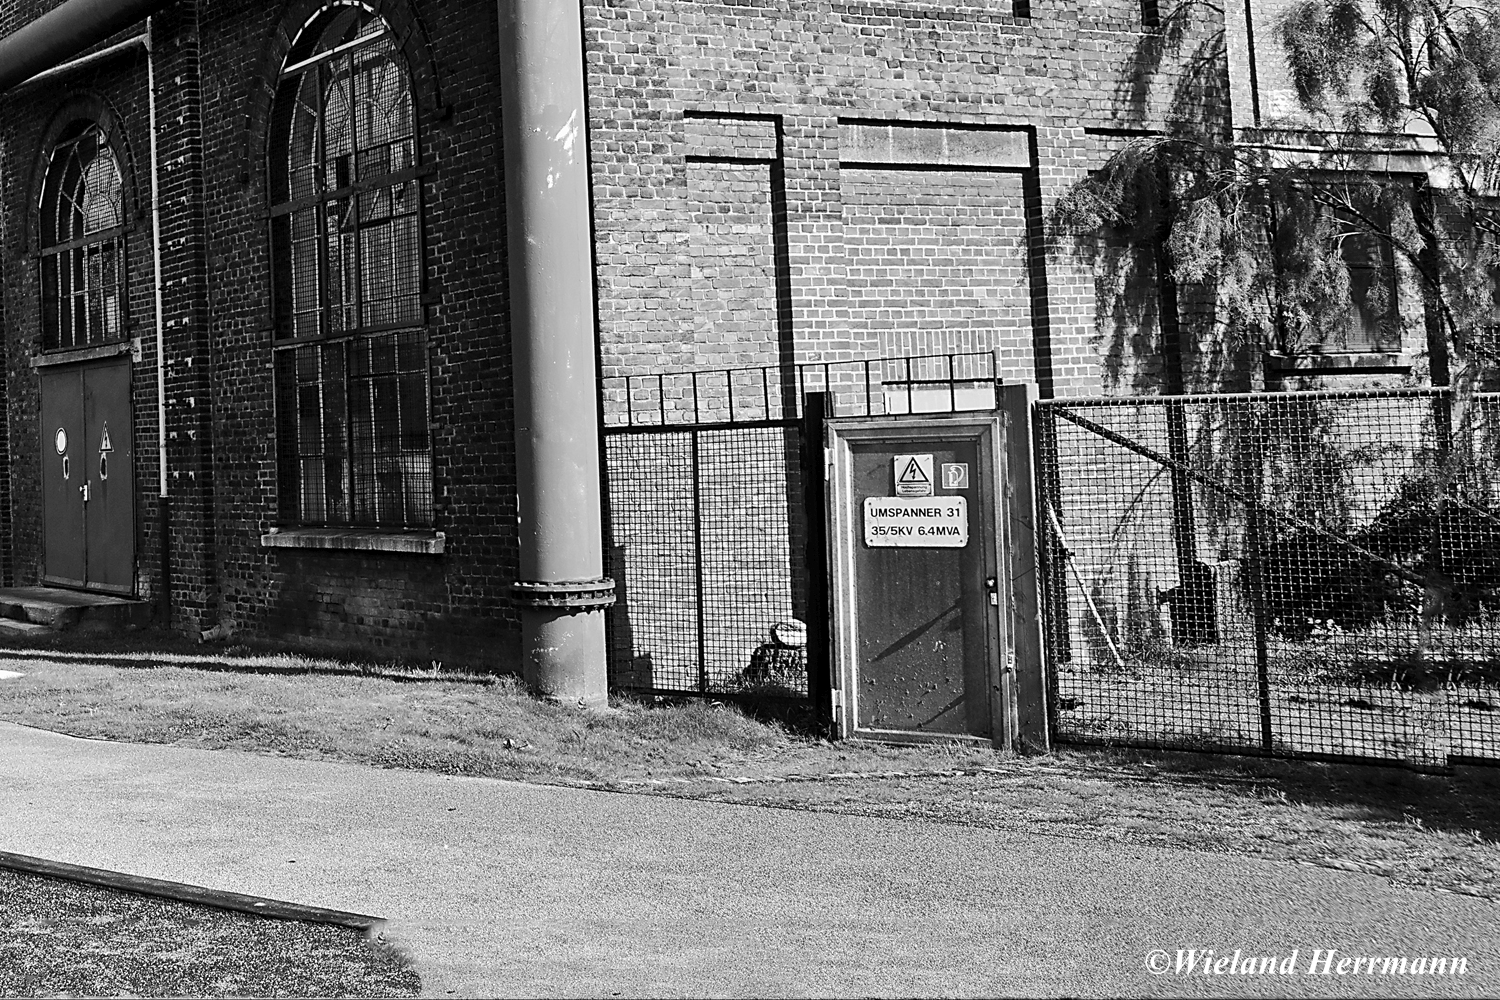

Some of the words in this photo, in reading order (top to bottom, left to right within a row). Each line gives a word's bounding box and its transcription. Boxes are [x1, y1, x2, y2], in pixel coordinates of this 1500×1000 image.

[870, 508, 942, 518] UMSPANNER
[946, 507, 961, 518] 31
[871, 526, 913, 536] 35/5KV
[917, 526, 961, 536] 6.4MVA
